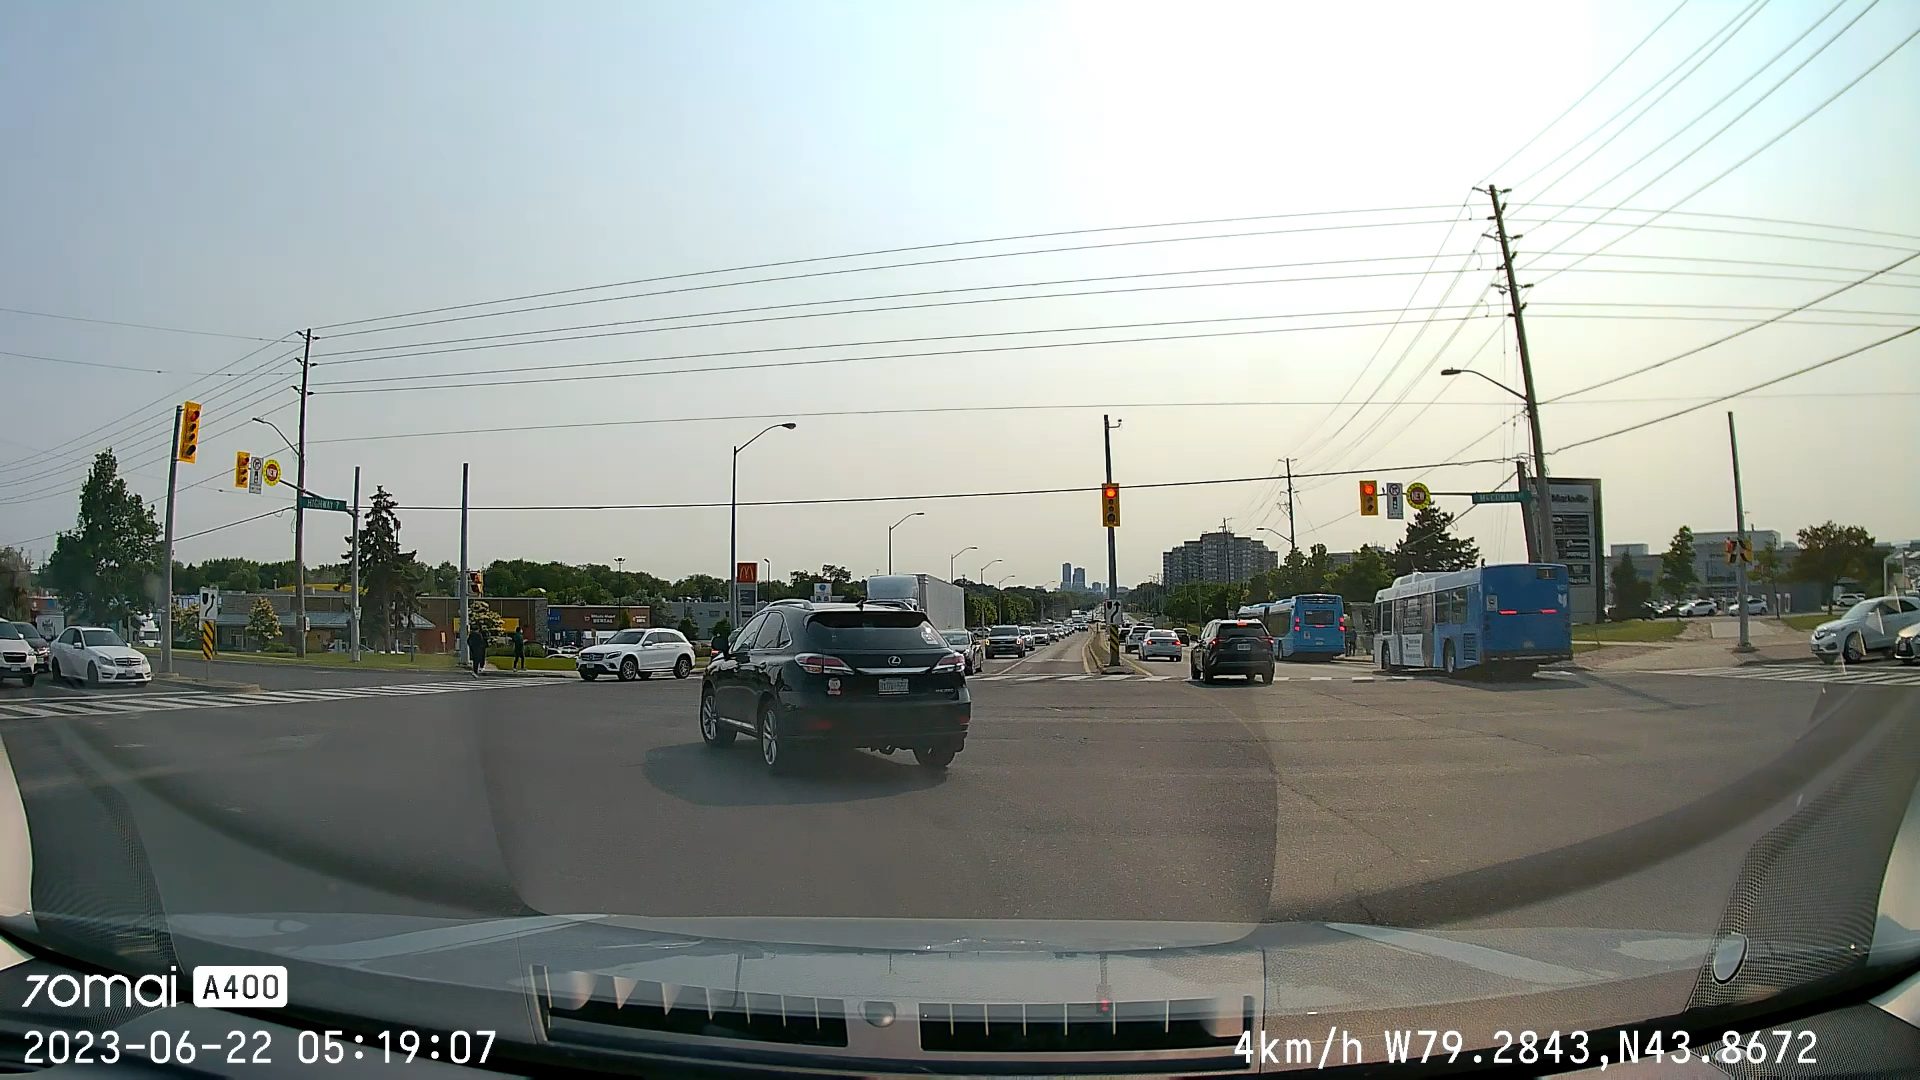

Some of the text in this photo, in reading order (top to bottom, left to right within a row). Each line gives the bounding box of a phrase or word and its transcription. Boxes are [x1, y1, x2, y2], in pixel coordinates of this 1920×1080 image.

[266, 468, 278, 479] NEW
[1411, 490, 1426, 501] NEW
[307, 497, 334, 510] HIGHWAY
